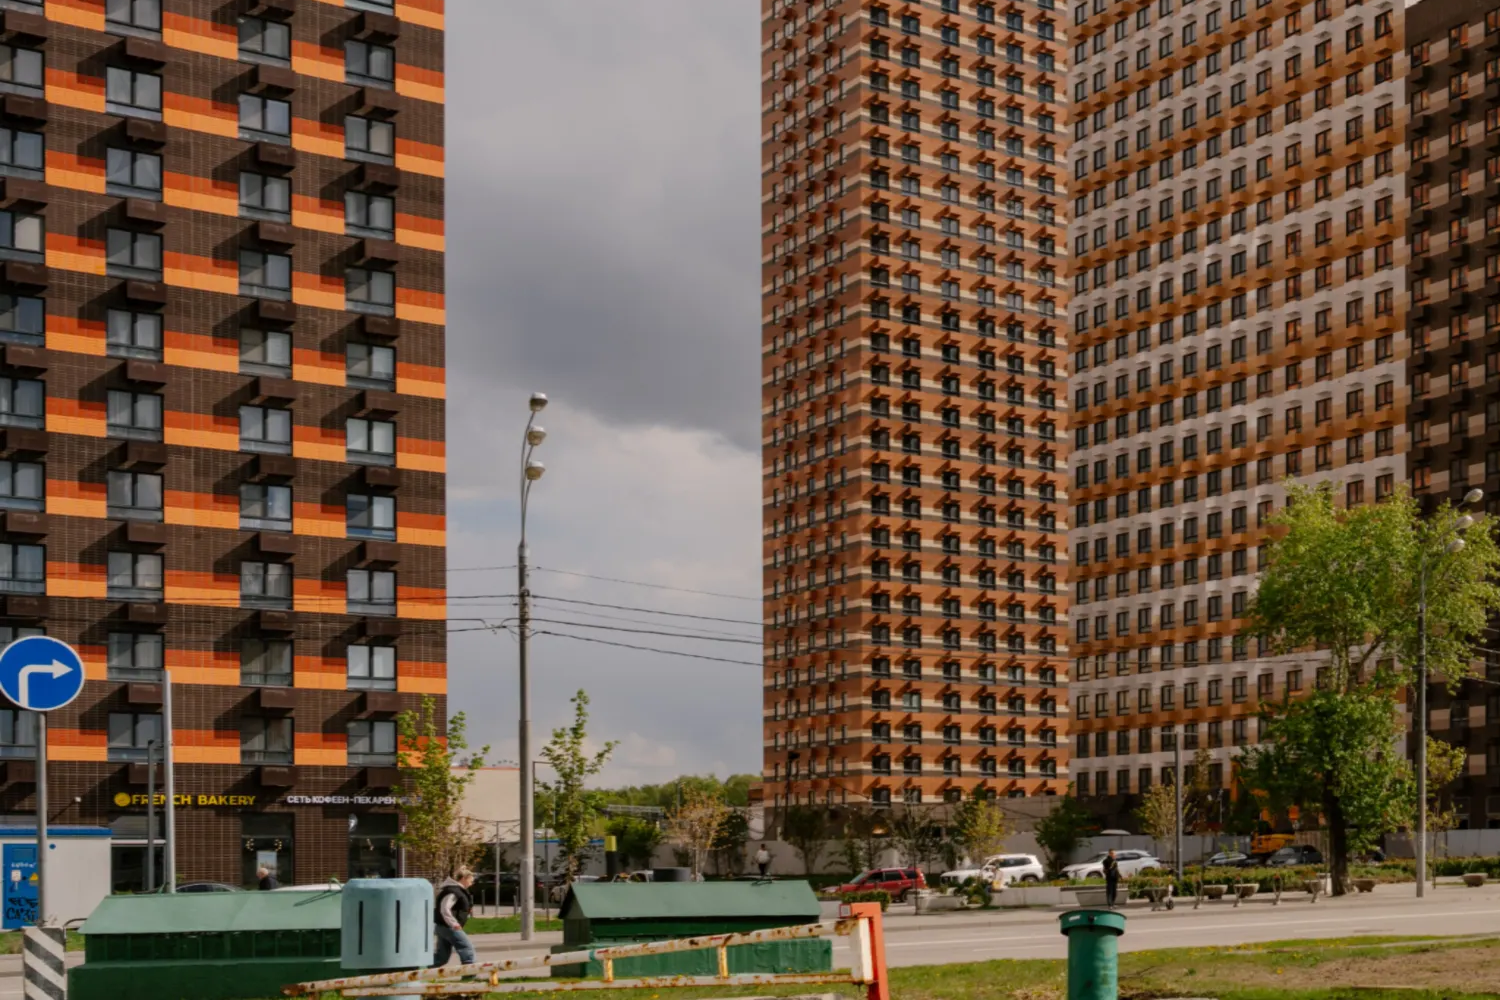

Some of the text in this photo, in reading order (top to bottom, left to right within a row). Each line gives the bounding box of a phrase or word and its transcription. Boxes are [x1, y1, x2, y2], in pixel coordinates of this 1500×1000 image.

[132, 794, 256, 806] FRENCH BAKERY
[287, 795, 311, 804] СЕТЬ
